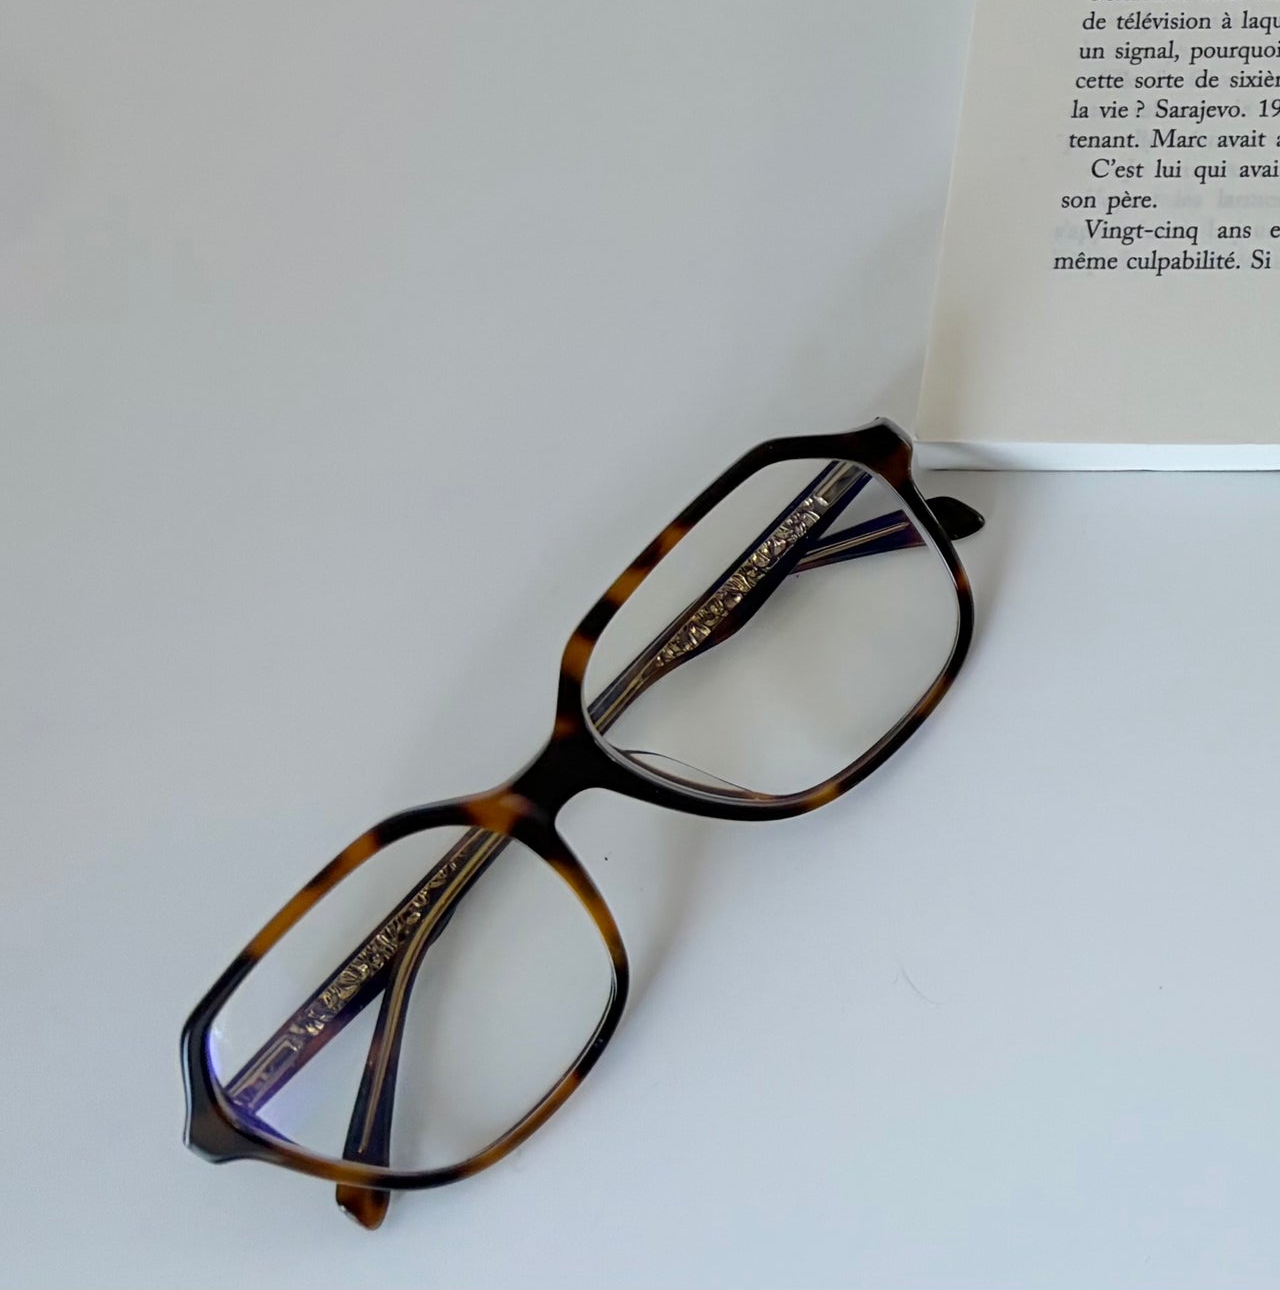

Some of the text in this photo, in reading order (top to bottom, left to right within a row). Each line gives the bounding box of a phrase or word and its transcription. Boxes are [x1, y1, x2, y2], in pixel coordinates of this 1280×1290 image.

[1075, 74, 1125, 89] cette
[1134, 73, 1185, 89] sorte
[1194, 68, 1220, 89] de
[1068, 133, 1140, 149] tenant.
[1149, 128, 1208, 149] Marc
[1217, 129, 1267, 148] avait
[1060, 190, 1158, 216] son père.
[1084, 218, 1199, 247] Vingt-cinq
[1216, 225, 1252, 240] ans
[1053, 251, 1119, 270] même
[1126, 249, 1241, 277] culpabilité.
[1250, 248, 1272, 270] Si
